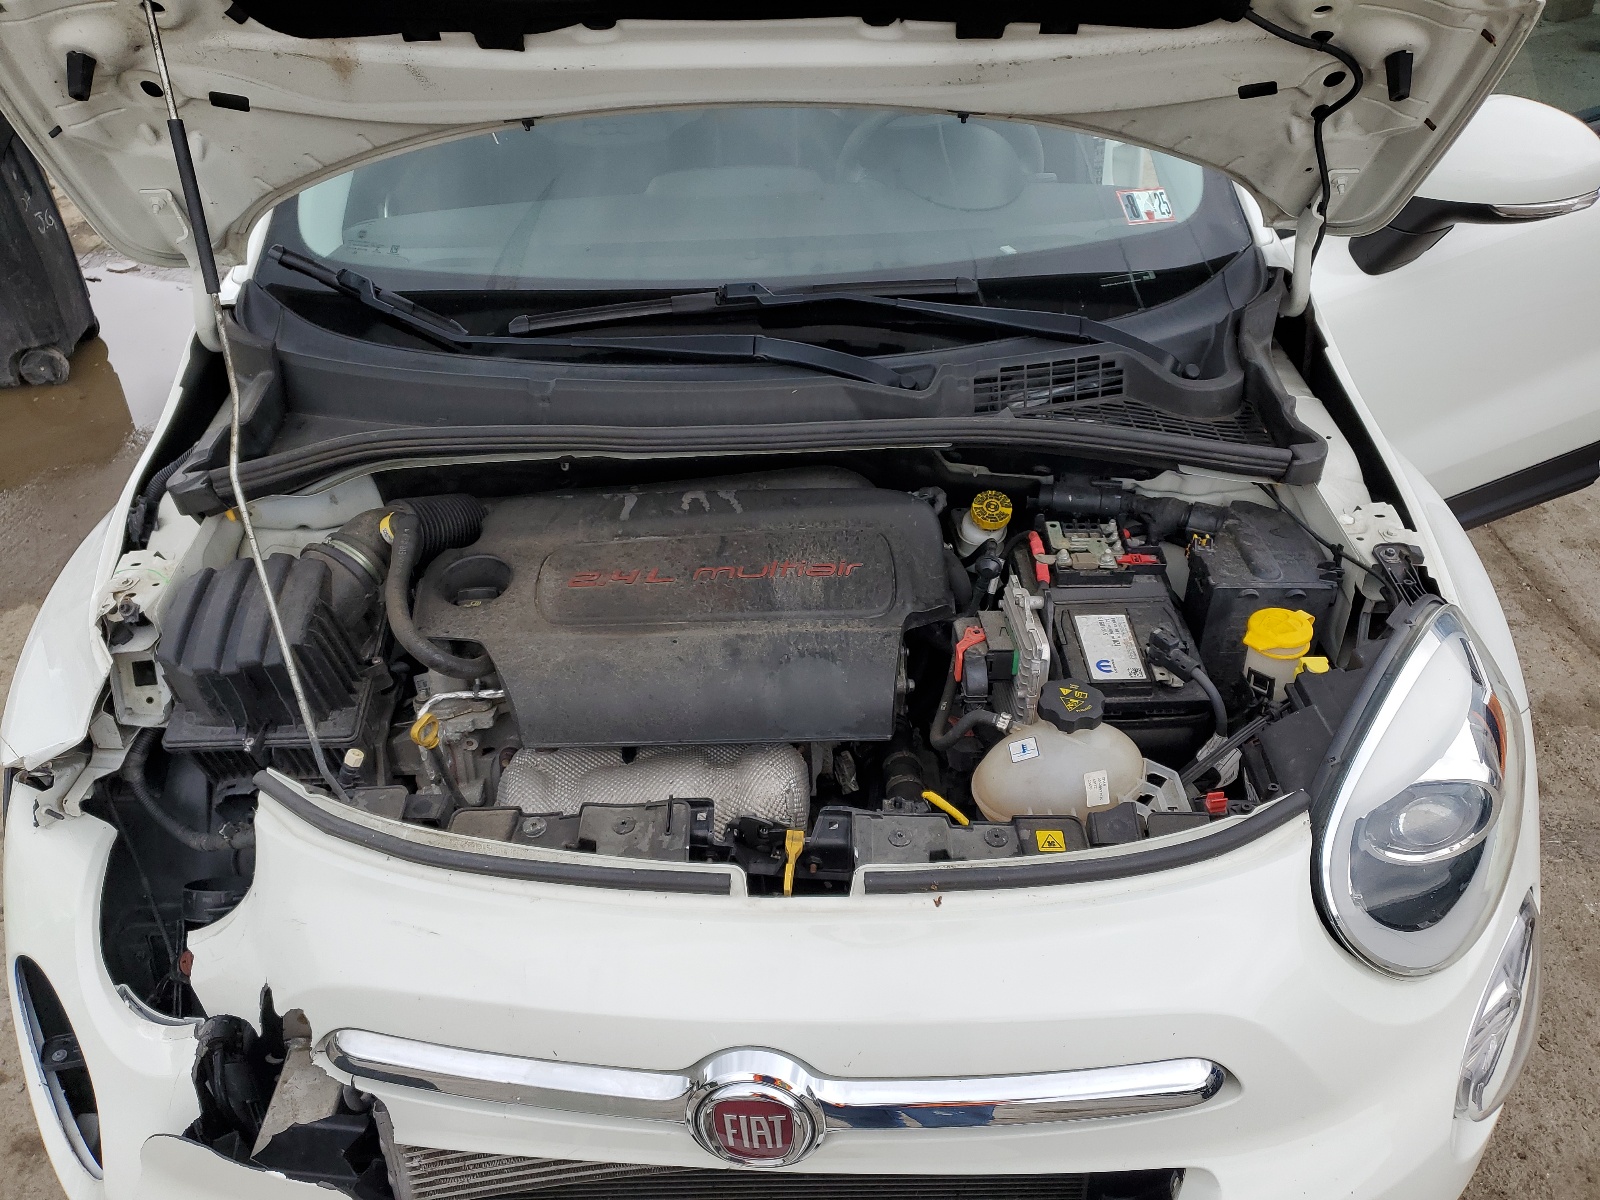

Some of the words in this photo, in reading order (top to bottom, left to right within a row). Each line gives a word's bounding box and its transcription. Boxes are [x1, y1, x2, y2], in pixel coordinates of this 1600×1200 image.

[1154, 191, 1171, 216] 25
[693, 559, 863, 581] multiair
[723, 1113, 787, 1149] FIAT
